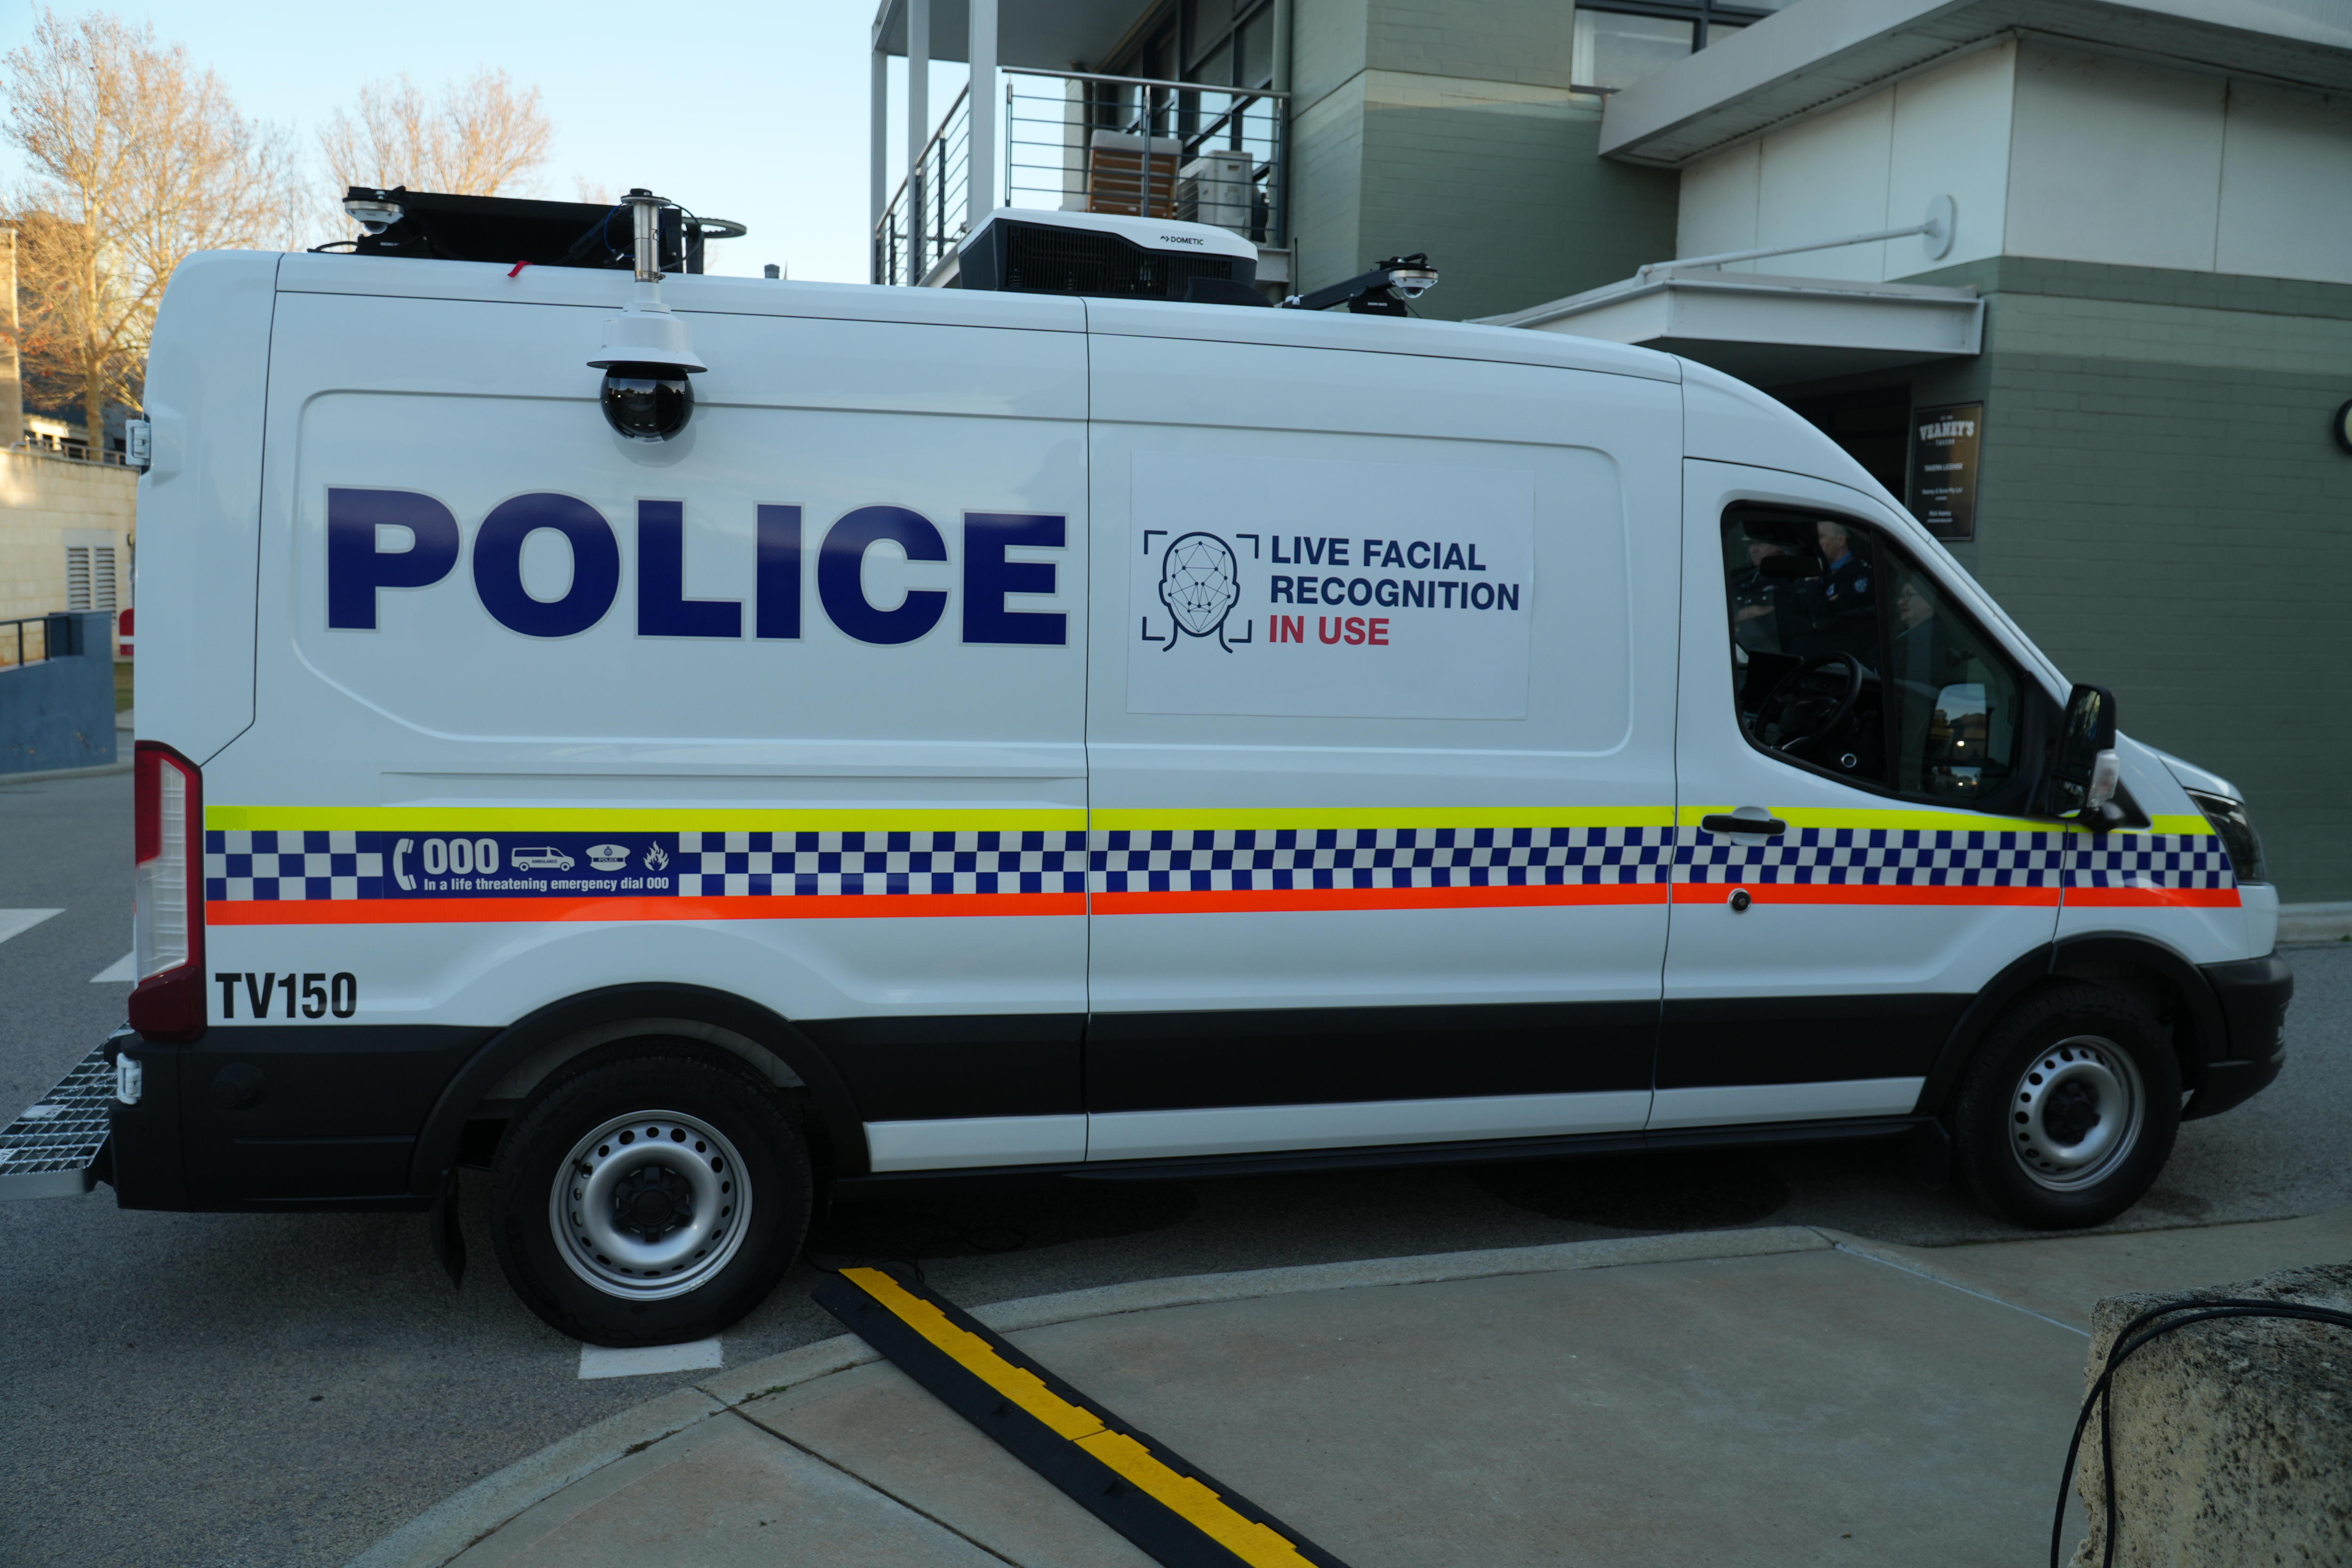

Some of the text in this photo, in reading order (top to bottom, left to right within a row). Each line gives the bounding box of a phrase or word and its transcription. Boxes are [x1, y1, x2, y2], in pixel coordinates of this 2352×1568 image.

[1170, 236, 1204, 246] DOMETIC
[328, 488, 1068, 646] POLICE
[1271, 535, 1487, 572] LIVE FACIAL
[1271, 575, 1520, 612] RECOGNITION
[1270, 615, 1390, 646] IN USE
[423, 838, 500, 875] 000
[424, 877, 670, 892] In a life threatening emergency dial 000
[215, 972, 358, 1020] TV150
